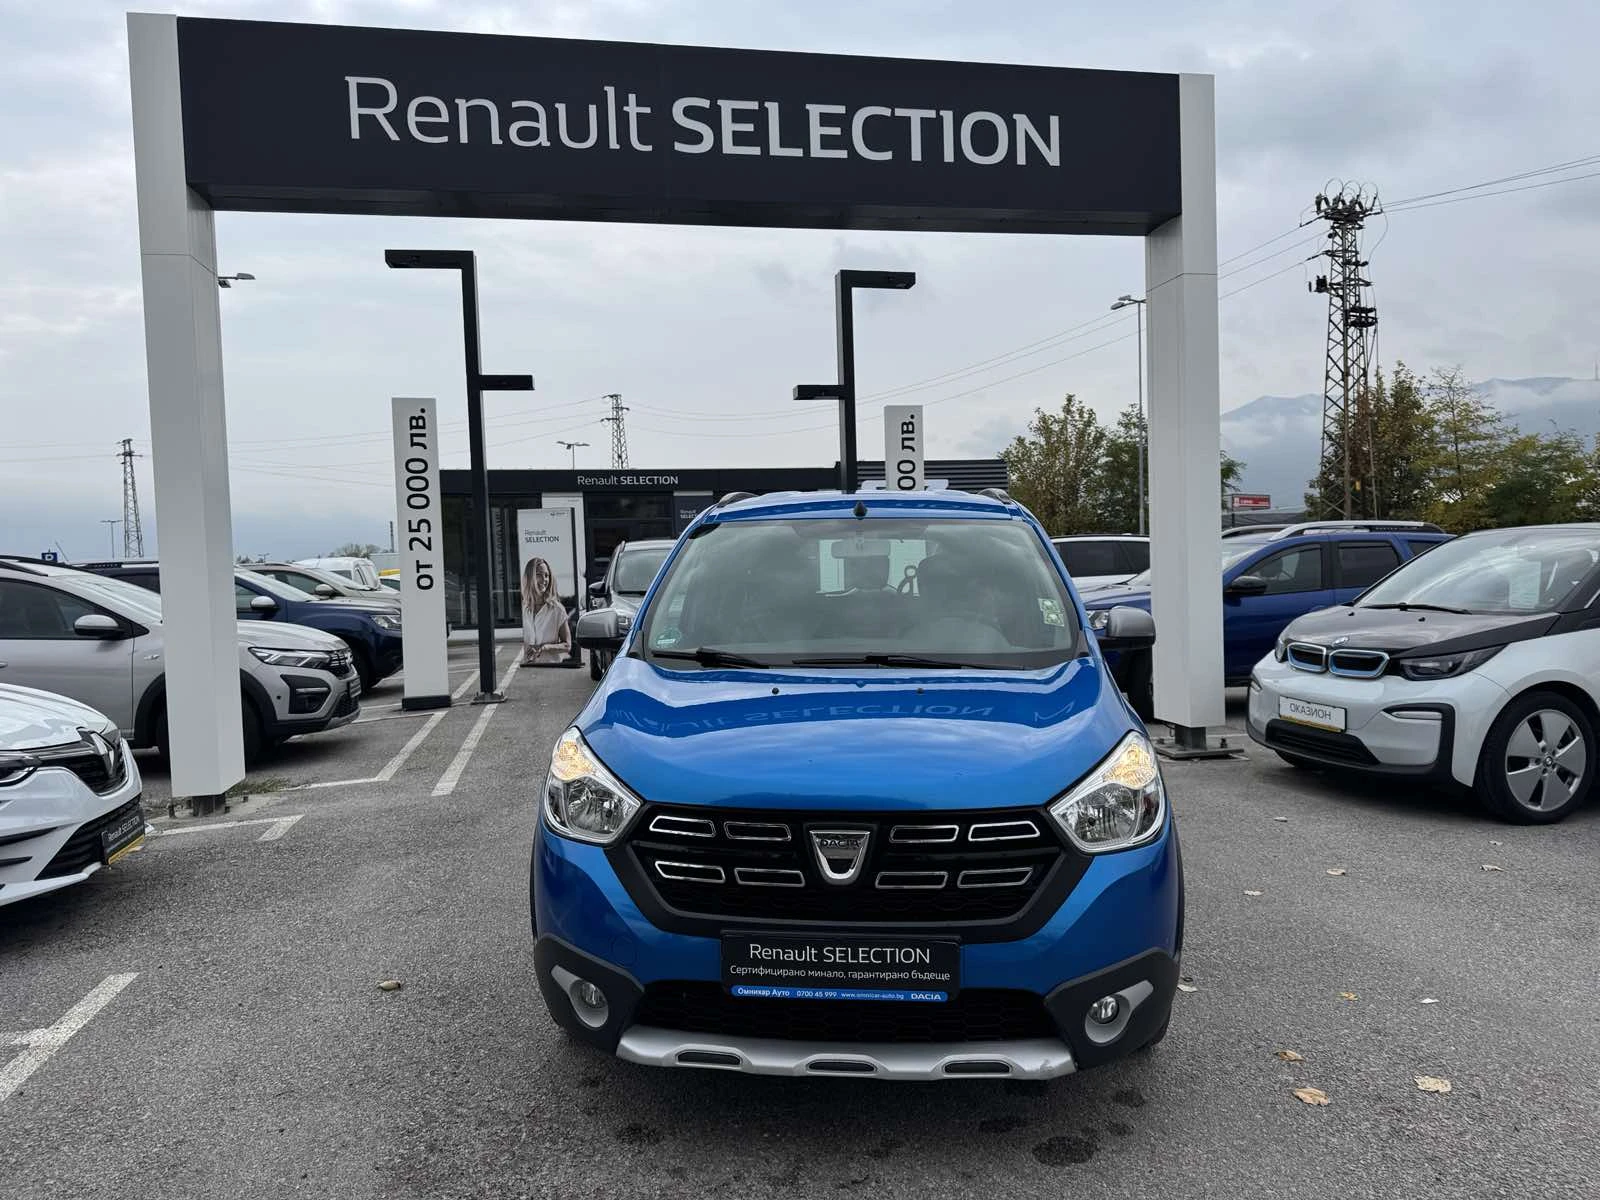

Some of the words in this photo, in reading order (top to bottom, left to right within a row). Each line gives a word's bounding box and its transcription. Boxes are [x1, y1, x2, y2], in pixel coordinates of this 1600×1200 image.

[344, 75, 653, 152] Renault
[672, 97, 1061, 167] SELECTION
[409, 407, 427, 449] лв.
[901, 414, 915, 452] лв.
[405, 457, 430, 510] 000
[577, 475, 618, 485] Renault
[620, 475, 679, 485] SELECTION
[408, 518, 432, 551] 25
[525, 535, 560, 543] SELECTION
[416, 560, 434, 590] от
[1290, 702, 1332, 720] ОКАЗИОН
[820, 839, 861, 848] DACIA
[749, 943, 818, 962] Renault
[823, 946, 930, 964] SELECTION
[730, 965, 806, 977] Сертифицирано
[808, 968, 846, 979] минало,
[848, 970, 910, 980] гарантирано
[911, 969, 951, 981] бъдеще
[772, 989, 790, 997] Ауто
